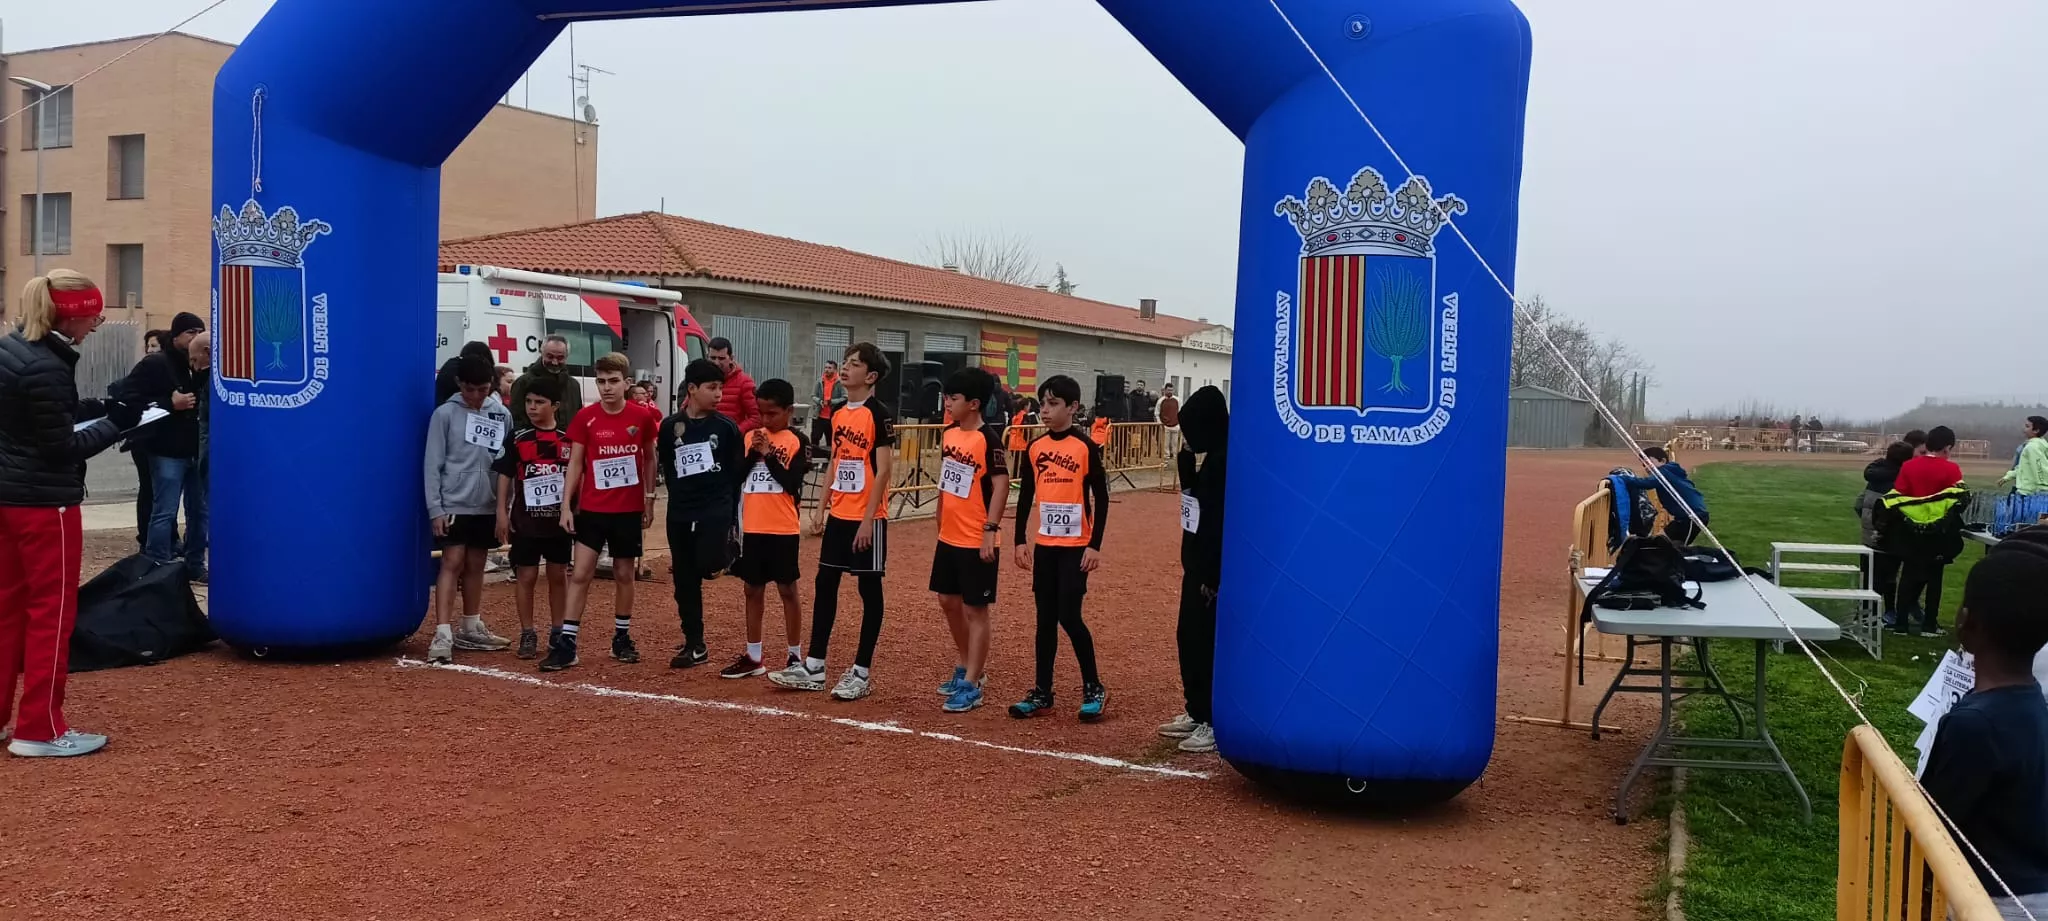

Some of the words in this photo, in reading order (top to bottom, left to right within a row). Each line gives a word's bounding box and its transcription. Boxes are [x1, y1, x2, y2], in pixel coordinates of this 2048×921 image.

[313, 293, 327, 352] LITERA
[1442, 293, 1458, 370] LITERA
[436, 334, 448, 348] ja
[315, 358, 329, 379] DE
[1274, 292, 1311, 437] AYUNTAMIENTO
[229, 393, 245, 404] DE
[250, 381, 322, 407] TAMARITE
[1441, 378, 1455, 408] DE
[475, 425, 497, 437] 056
[1353, 408, 1449, 443] TAMARITE
[1318, 426, 1344, 441] DE
[598, 444, 639, 455] HINACO
[681, 453, 703, 466] 032
[603, 466, 626, 478] 021
[752, 472, 772, 482] 052
[838, 470, 855, 481] 030
[944, 469, 962, 484] 039
[534, 484, 558, 496] 070
[1047, 513, 1070, 525] 020
[1953, 672, 1972, 684] LITERA
